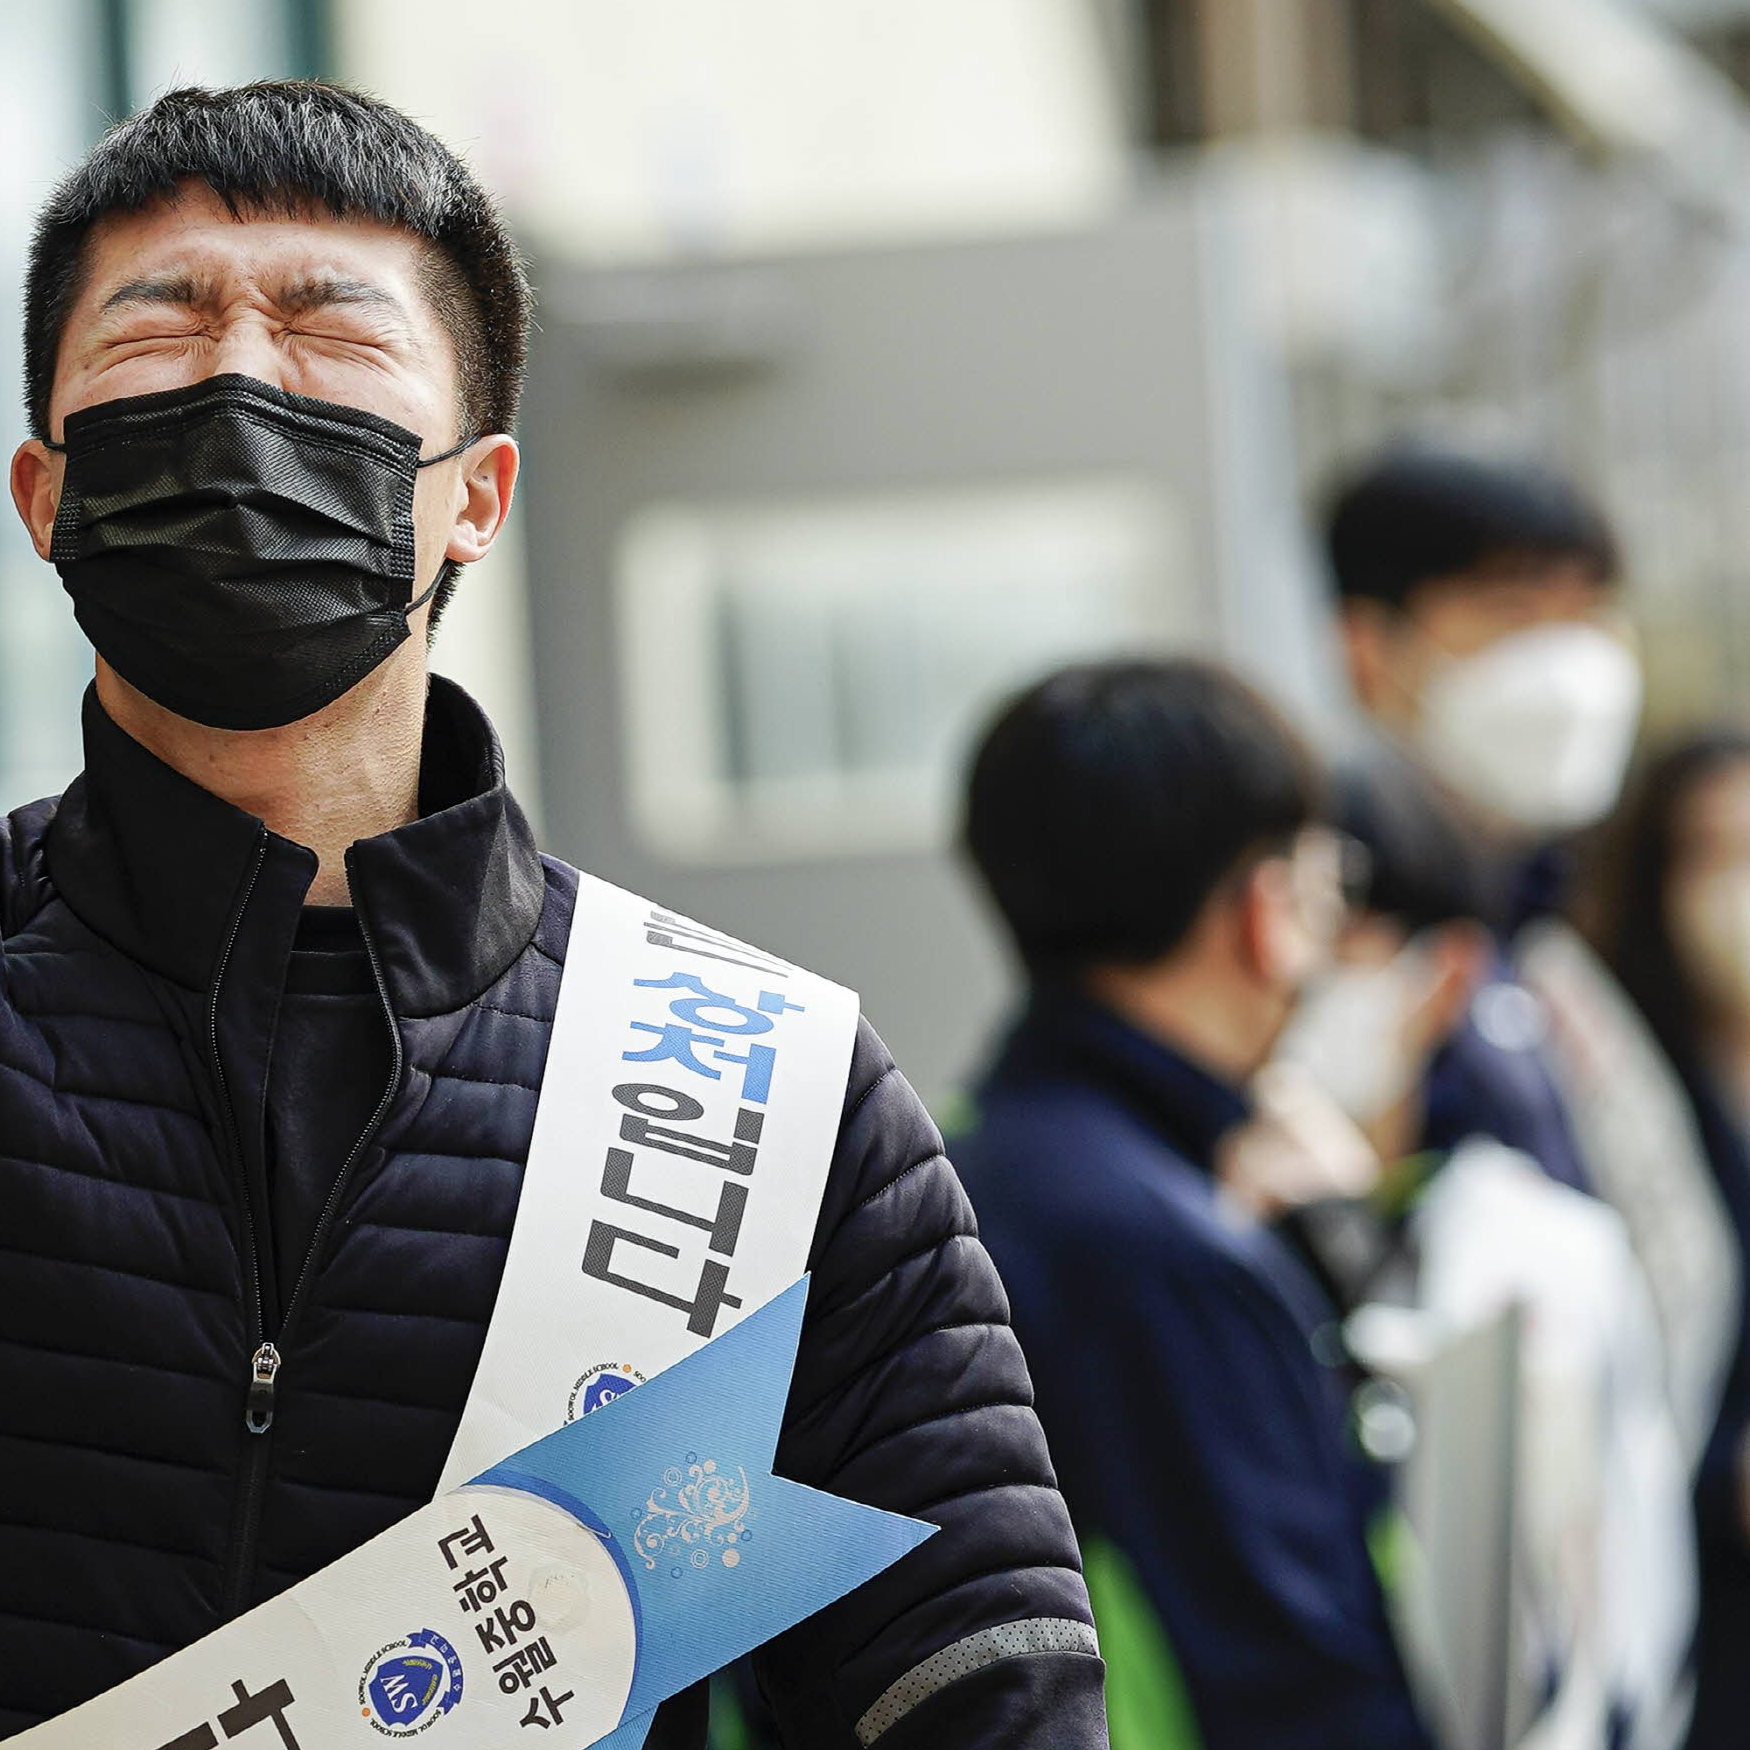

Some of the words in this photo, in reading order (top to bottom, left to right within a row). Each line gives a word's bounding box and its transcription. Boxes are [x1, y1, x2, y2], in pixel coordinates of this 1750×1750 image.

[581, 972, 805, 1338] 상처입니다
[380, 1674, 418, 1713] SW
[437, 1514, 577, 1733] 수월중학교
